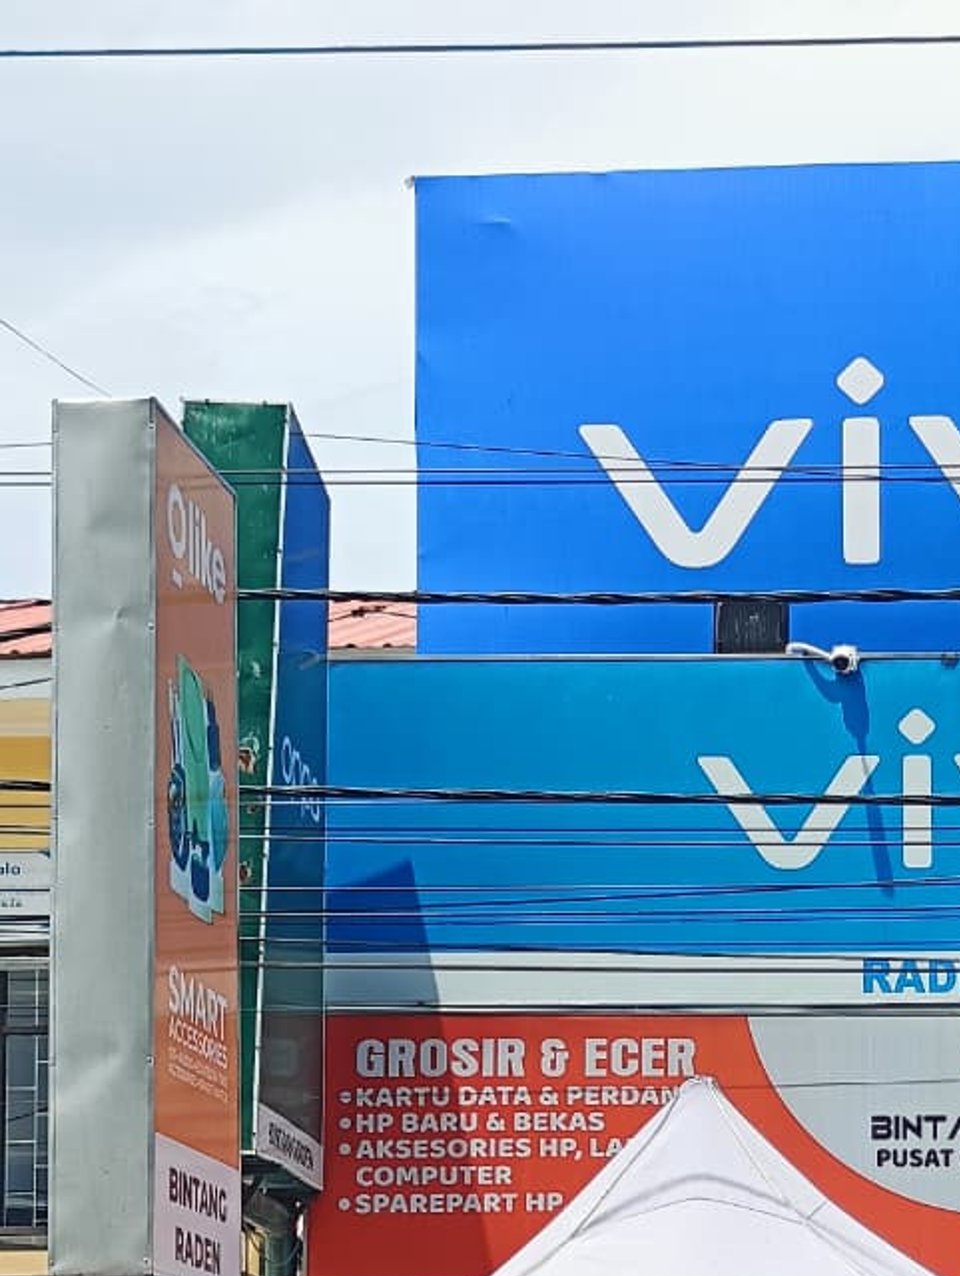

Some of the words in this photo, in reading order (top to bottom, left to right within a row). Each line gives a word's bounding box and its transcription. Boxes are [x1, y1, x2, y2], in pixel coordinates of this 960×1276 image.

[167, 484, 226, 603] Olike
[168, 964, 228, 1041] SMART
[168, 1016, 228, 1070] ACCESSORIES
[355, 1038, 526, 1077] GROSIR
[540, 1038, 569, 1077] &
[585, 1038, 695, 1077] ECER
[356, 1087, 450, 1107] KARTU
[458, 1086, 532, 1106] DATA
[540, 1086, 558, 1106] &
[567, 1085, 680, 1106] PERDAN
[356, 1114, 393, 1133] HP
[402, 1113, 477, 1133] BARU
[486, 1113, 505, 1132] &
[514, 1112, 605, 1131] BEKAS
[356, 1139, 531, 1159] AKSESORIES
[540, 1139, 582, 1160] HP,
[590, 1138, 630, 1158] LA
[877, 1149, 954, 1167] PUSAT
[356, 1166, 512, 1186] COMPUTER
[169, 1168, 227, 1223] BINTANG
[355, 1194, 517, 1213] SPAREPART
[525, 1193, 563, 1212] HP
[175, 1227, 221, 1275] RADEN
